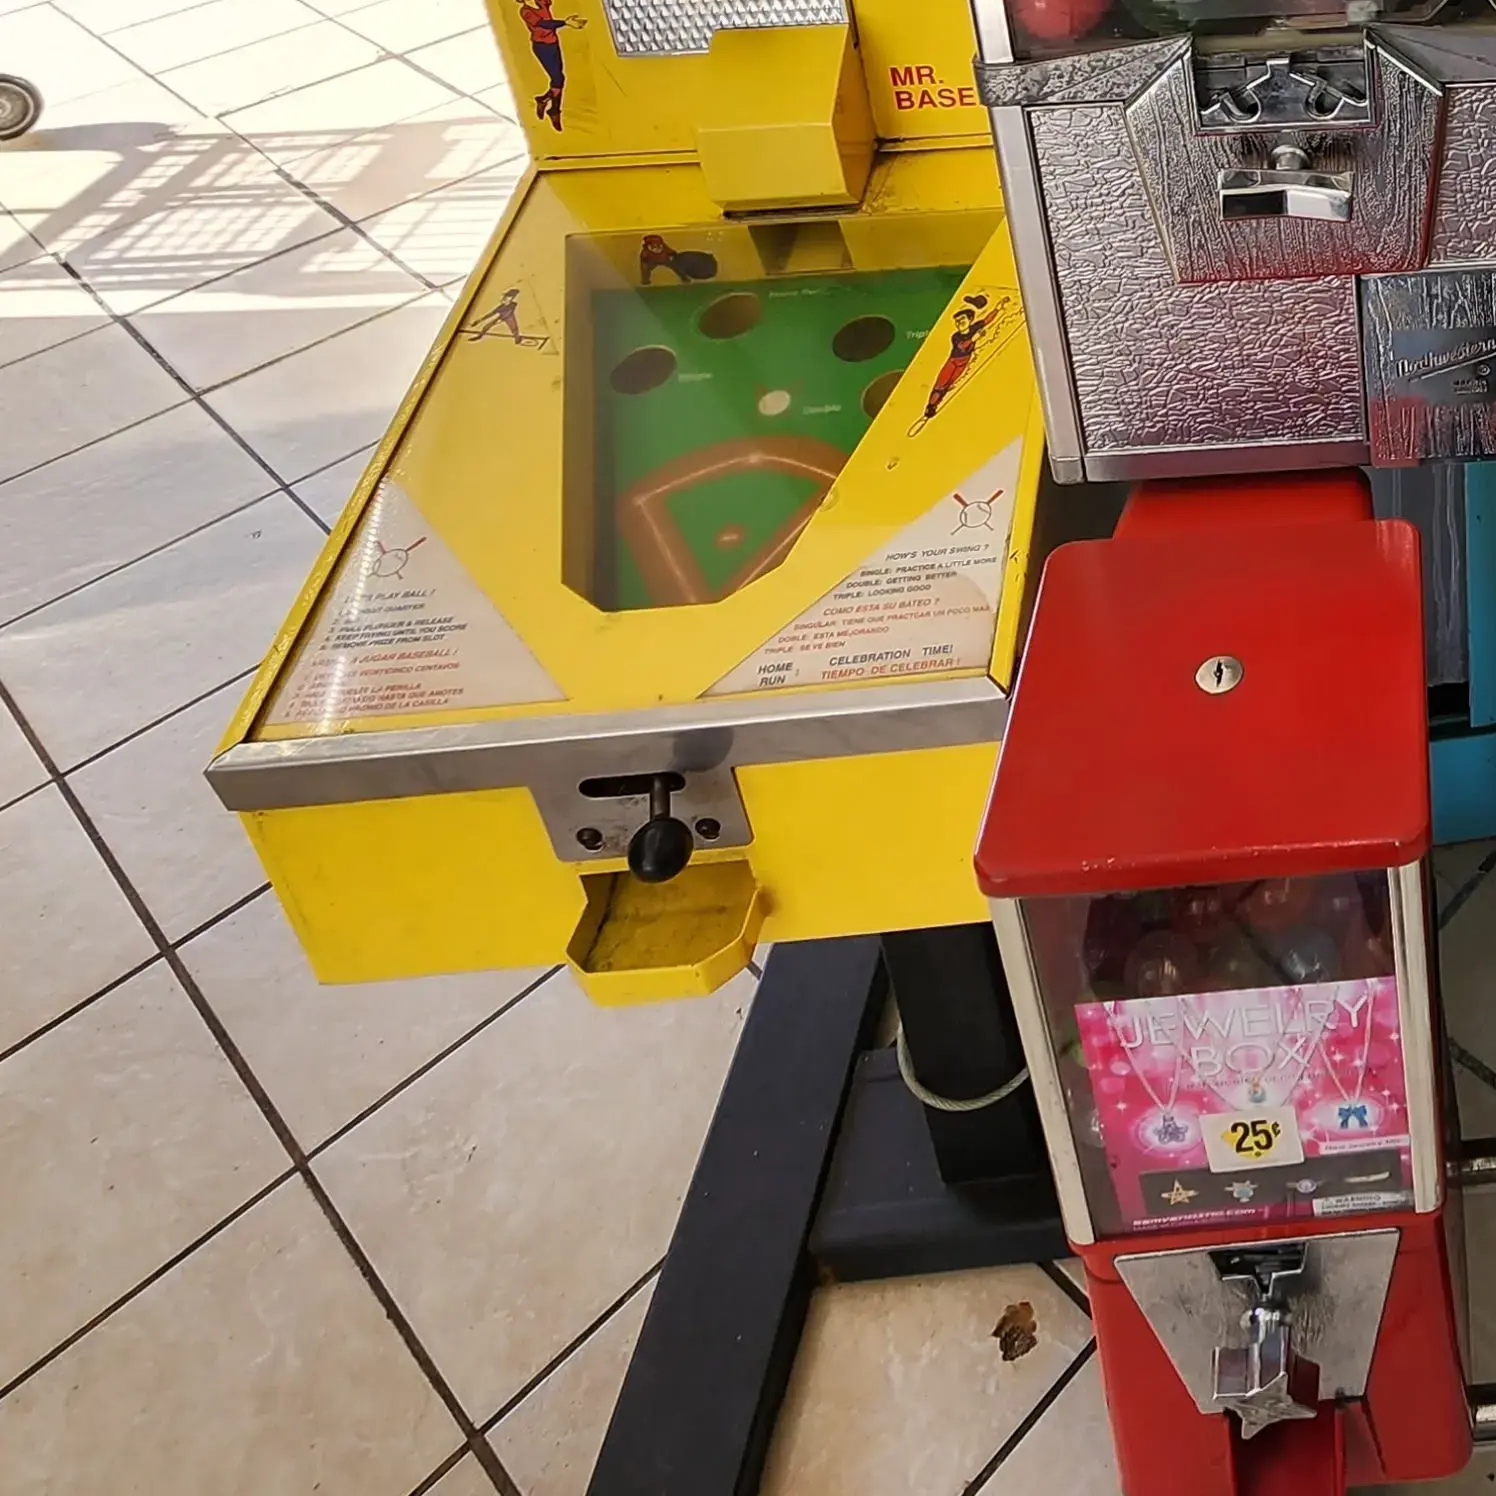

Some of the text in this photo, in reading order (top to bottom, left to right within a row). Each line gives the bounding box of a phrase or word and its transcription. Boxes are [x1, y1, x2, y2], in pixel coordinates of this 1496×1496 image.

[889, 66, 944, 86] MR.
[921, 548, 947, 559] YOUR
[950, 545, 981, 554] SWING
[896, 563, 936, 574] PRACTICE
[886, 575, 922, 584] GETTING
[924, 571, 958, 581] BETTER
[868, 587, 905, 597] LOOKING
[907, 584, 932, 593] GOOD
[823, 606, 854, 616] COMO
[856, 603, 882, 613] ESTA
[883, 601, 897, 610] SU
[899, 598, 933, 609] BATEO
[414, 616, 455, 626] RELEASE
[842, 616, 866, 626] TIENE
[867, 615, 884, 624] QUE
[419, 625, 437, 634] YOU
[437, 623, 469, 633] SCORE
[814, 631, 835, 640] ESTA
[836, 626, 889, 637] MEJORANDO
[396, 635, 422, 645] FROM
[422, 633, 446, 642] SLOT
[825, 640, 846, 649] BIEN
[829, 644, 954, 667] CELEBRATION TIME!
[757, 662, 793, 675] HOME
[821, 658, 954, 680] TIEMPO DE CELEBRAR
[758, 675, 786, 687] RUN
[1123, 993, 1369, 1049] JEWELRY
[1190, 1035, 1312, 1079] BOX
[1230, 1120, 1281, 1154] 25¢
